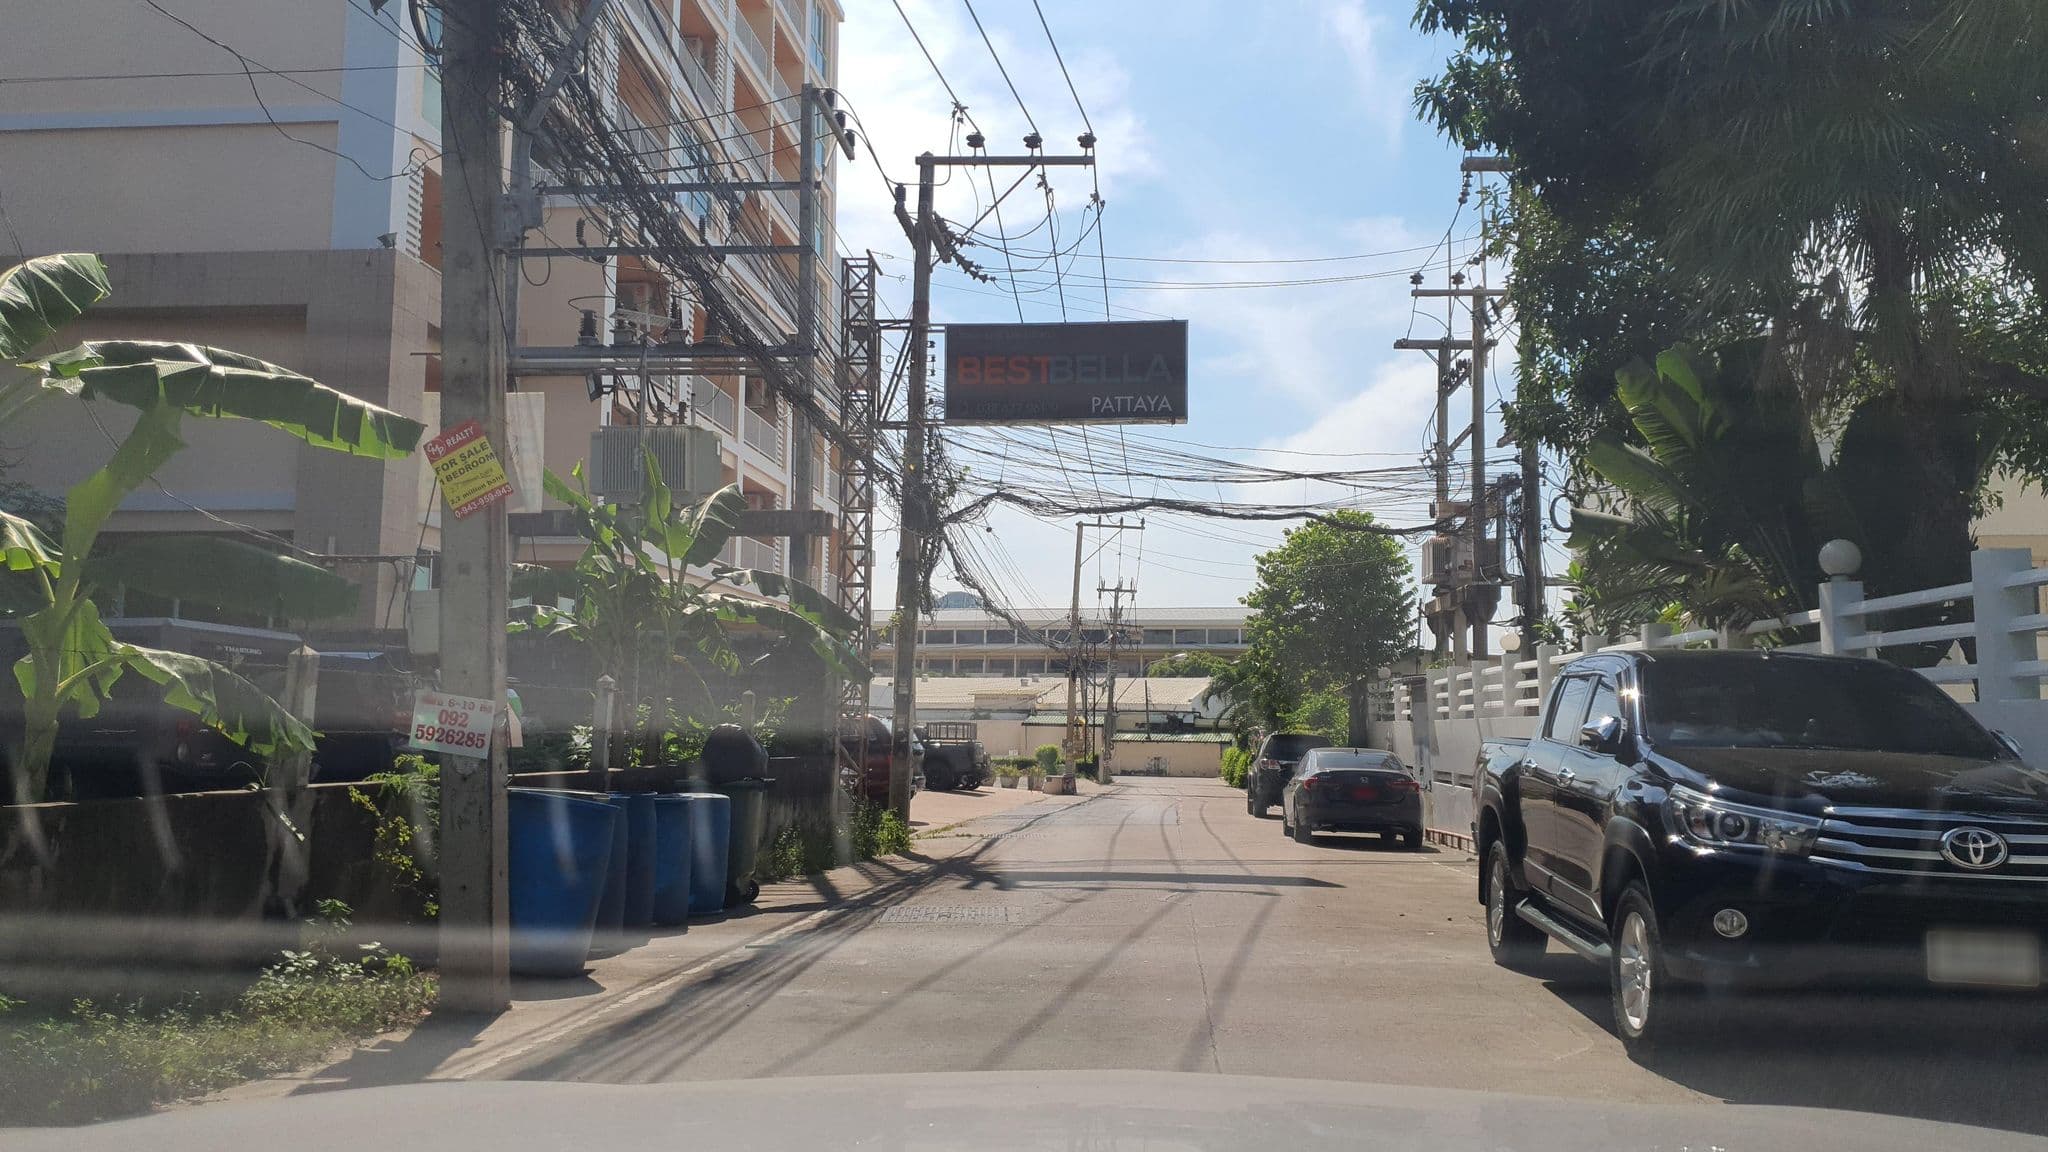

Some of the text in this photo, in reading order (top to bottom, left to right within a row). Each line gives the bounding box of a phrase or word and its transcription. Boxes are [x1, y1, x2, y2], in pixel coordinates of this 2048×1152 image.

[1091, 395, 1172, 413] PATTAYA
[446, 426, 474, 448] REALTY
[434, 441, 489, 475] FOR SALE
[445, 452, 495, 482] BEDROOM
[454, 485, 512, 518] 0-943-959-943
[462, 483, 487, 499] million
[438, 709, 469, 728] 092
[415, 724, 486, 749] 5926285
